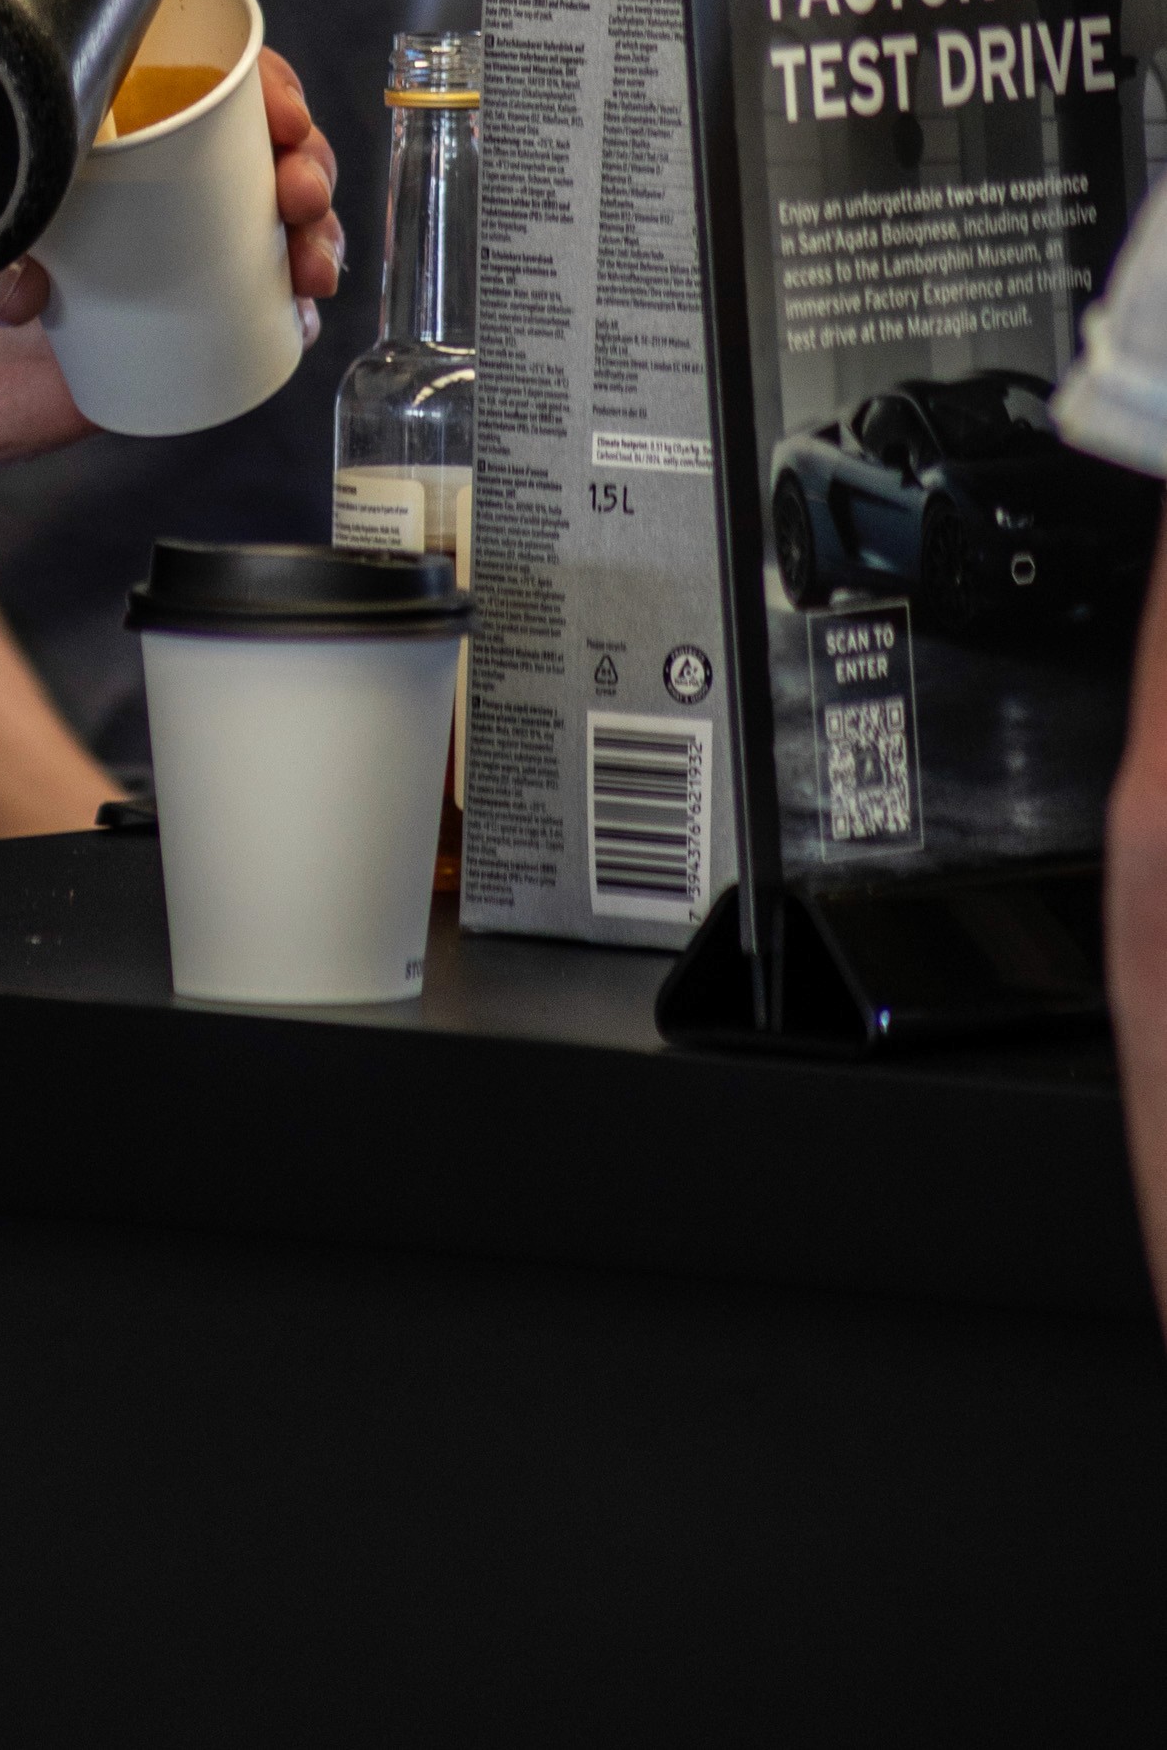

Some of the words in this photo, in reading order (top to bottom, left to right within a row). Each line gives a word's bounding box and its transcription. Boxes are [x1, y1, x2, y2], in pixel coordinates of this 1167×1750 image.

[770, 35, 919, 123] TEST
[937, 15, 1117, 108] DRIVE
[779, 199, 820, 229] Enjoy
[824, 202, 842, 221] an
[845, 187, 943, 218] unforgettable
[946, 180, 1007, 209] two-day
[1009, 174, 1089, 203] experience
[781, 233, 795, 256] in
[881, 218, 961, 247] Bolognese,
[963, 209, 1029, 237] including
[1032, 203, 1097, 231] exclusive
[784, 264, 833, 290] access
[836, 260, 852, 282] to
[855, 256, 880, 281] the
[883, 248, 974, 279] Lamborghini
[977, 241, 1042, 268] Museum,
[1045, 238, 1064, 260] an
[786, 292, 861, 321] immersive
[865, 285, 919, 312] Factory
[922, 276, 1003, 306] Experience
[1007, 271, 1034, 296] and
[1036, 265, 1092, 293] thrilling
[787, 327, 817, 352] test
[820, 322, 857, 348] drive
[860, 321, 876, 344] at
[879, 317, 905, 342] the
[907, 308, 978, 339] Marzaglia
[981, 303, 1033, 331] Circuit.
[623, 485, 635, 514] L
[825, 624, 870, 656] SCAN
[874, 622, 895, 650] TO
[835, 652, 889, 685] ENTER
[688, 742, 703, 813] 621932
[688, 824, 703, 896] 394376
[689, 910, 702, 923] 7
